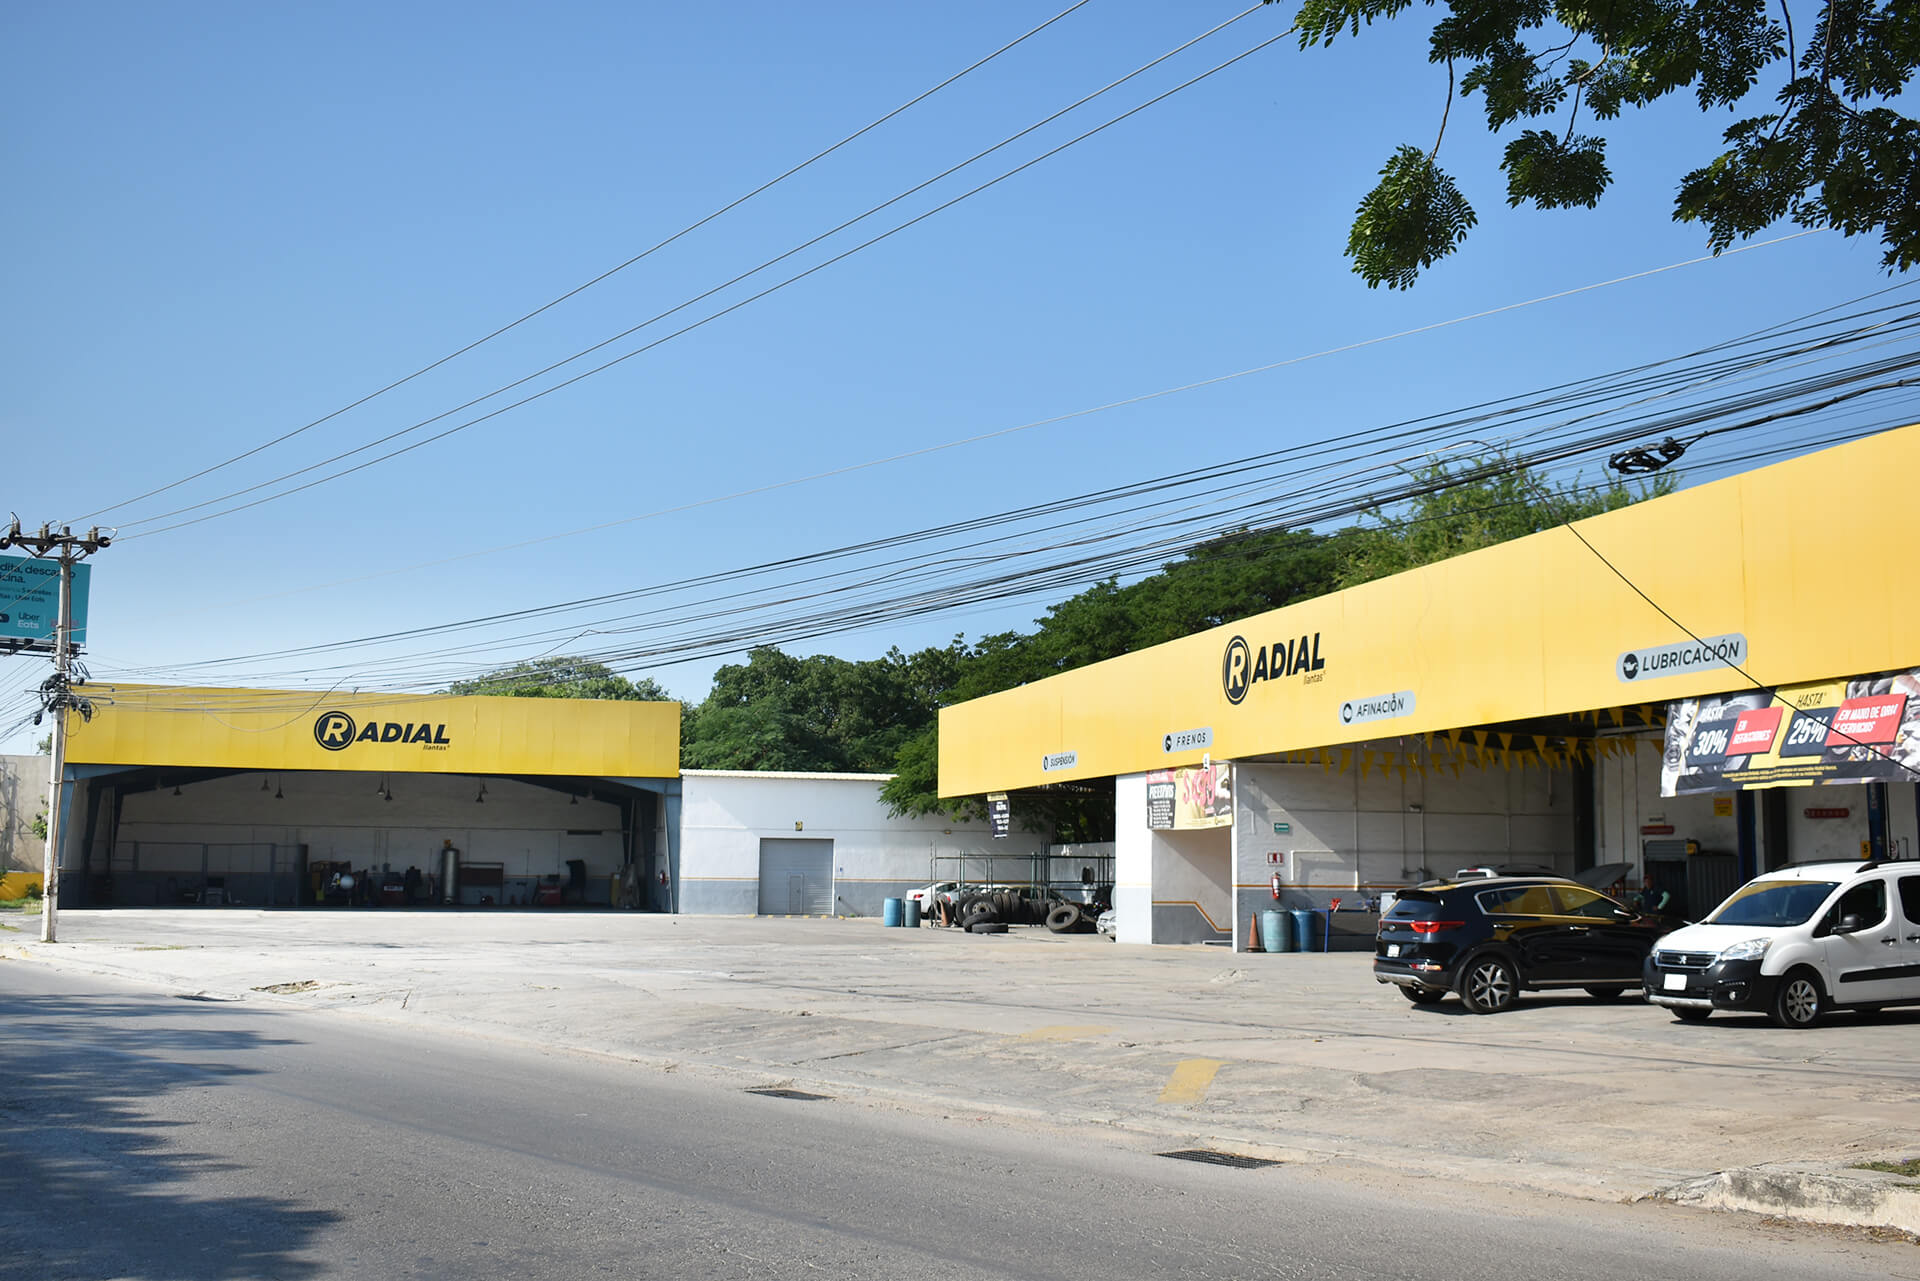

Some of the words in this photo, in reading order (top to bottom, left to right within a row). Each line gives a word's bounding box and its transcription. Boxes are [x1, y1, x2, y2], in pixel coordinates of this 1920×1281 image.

[17, 620, 39, 629] Eats
[18, 612, 40, 621] Uber
[1642, 638, 1740, 672] LUBRICACIÓN
[1222, 632, 1326, 706] RADIAL
[1356, 694, 1405, 718] AFINACIÓN
[314, 711, 450, 751] RADIAL
[1176, 732, 1207, 748] FRENOS
[1693, 729, 1728, 756] 30%
[1787, 716, 1828, 745] 25%
